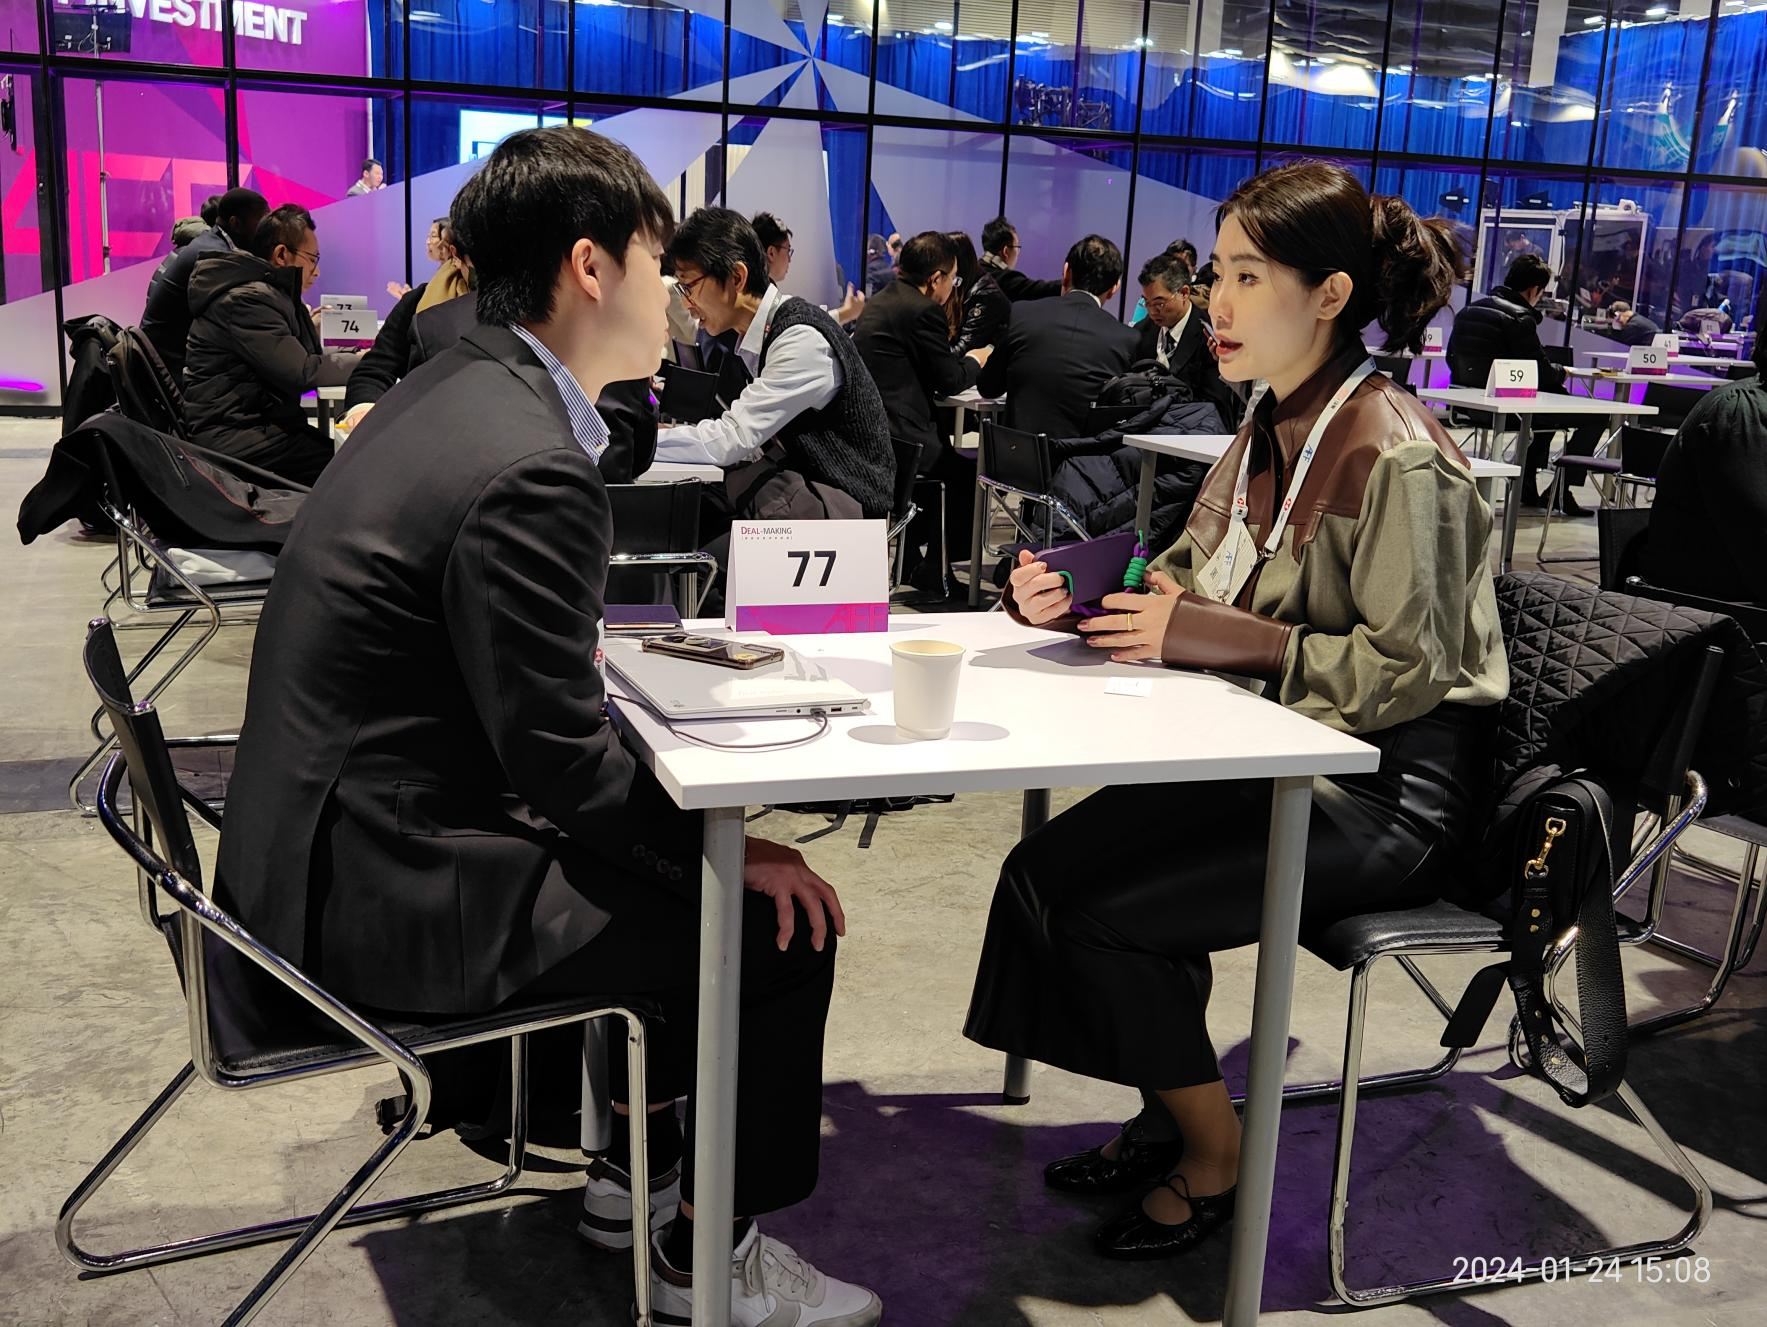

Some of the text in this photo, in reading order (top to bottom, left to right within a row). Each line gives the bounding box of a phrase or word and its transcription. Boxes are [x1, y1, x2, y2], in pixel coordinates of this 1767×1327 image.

[341, 320, 360, 333] 74
[1643, 353, 1657, 364] 50
[1510, 369, 1524, 383] 59
[741, 526, 793, 535] DEAL-MAKING
[787, 550, 837, 588] 77
